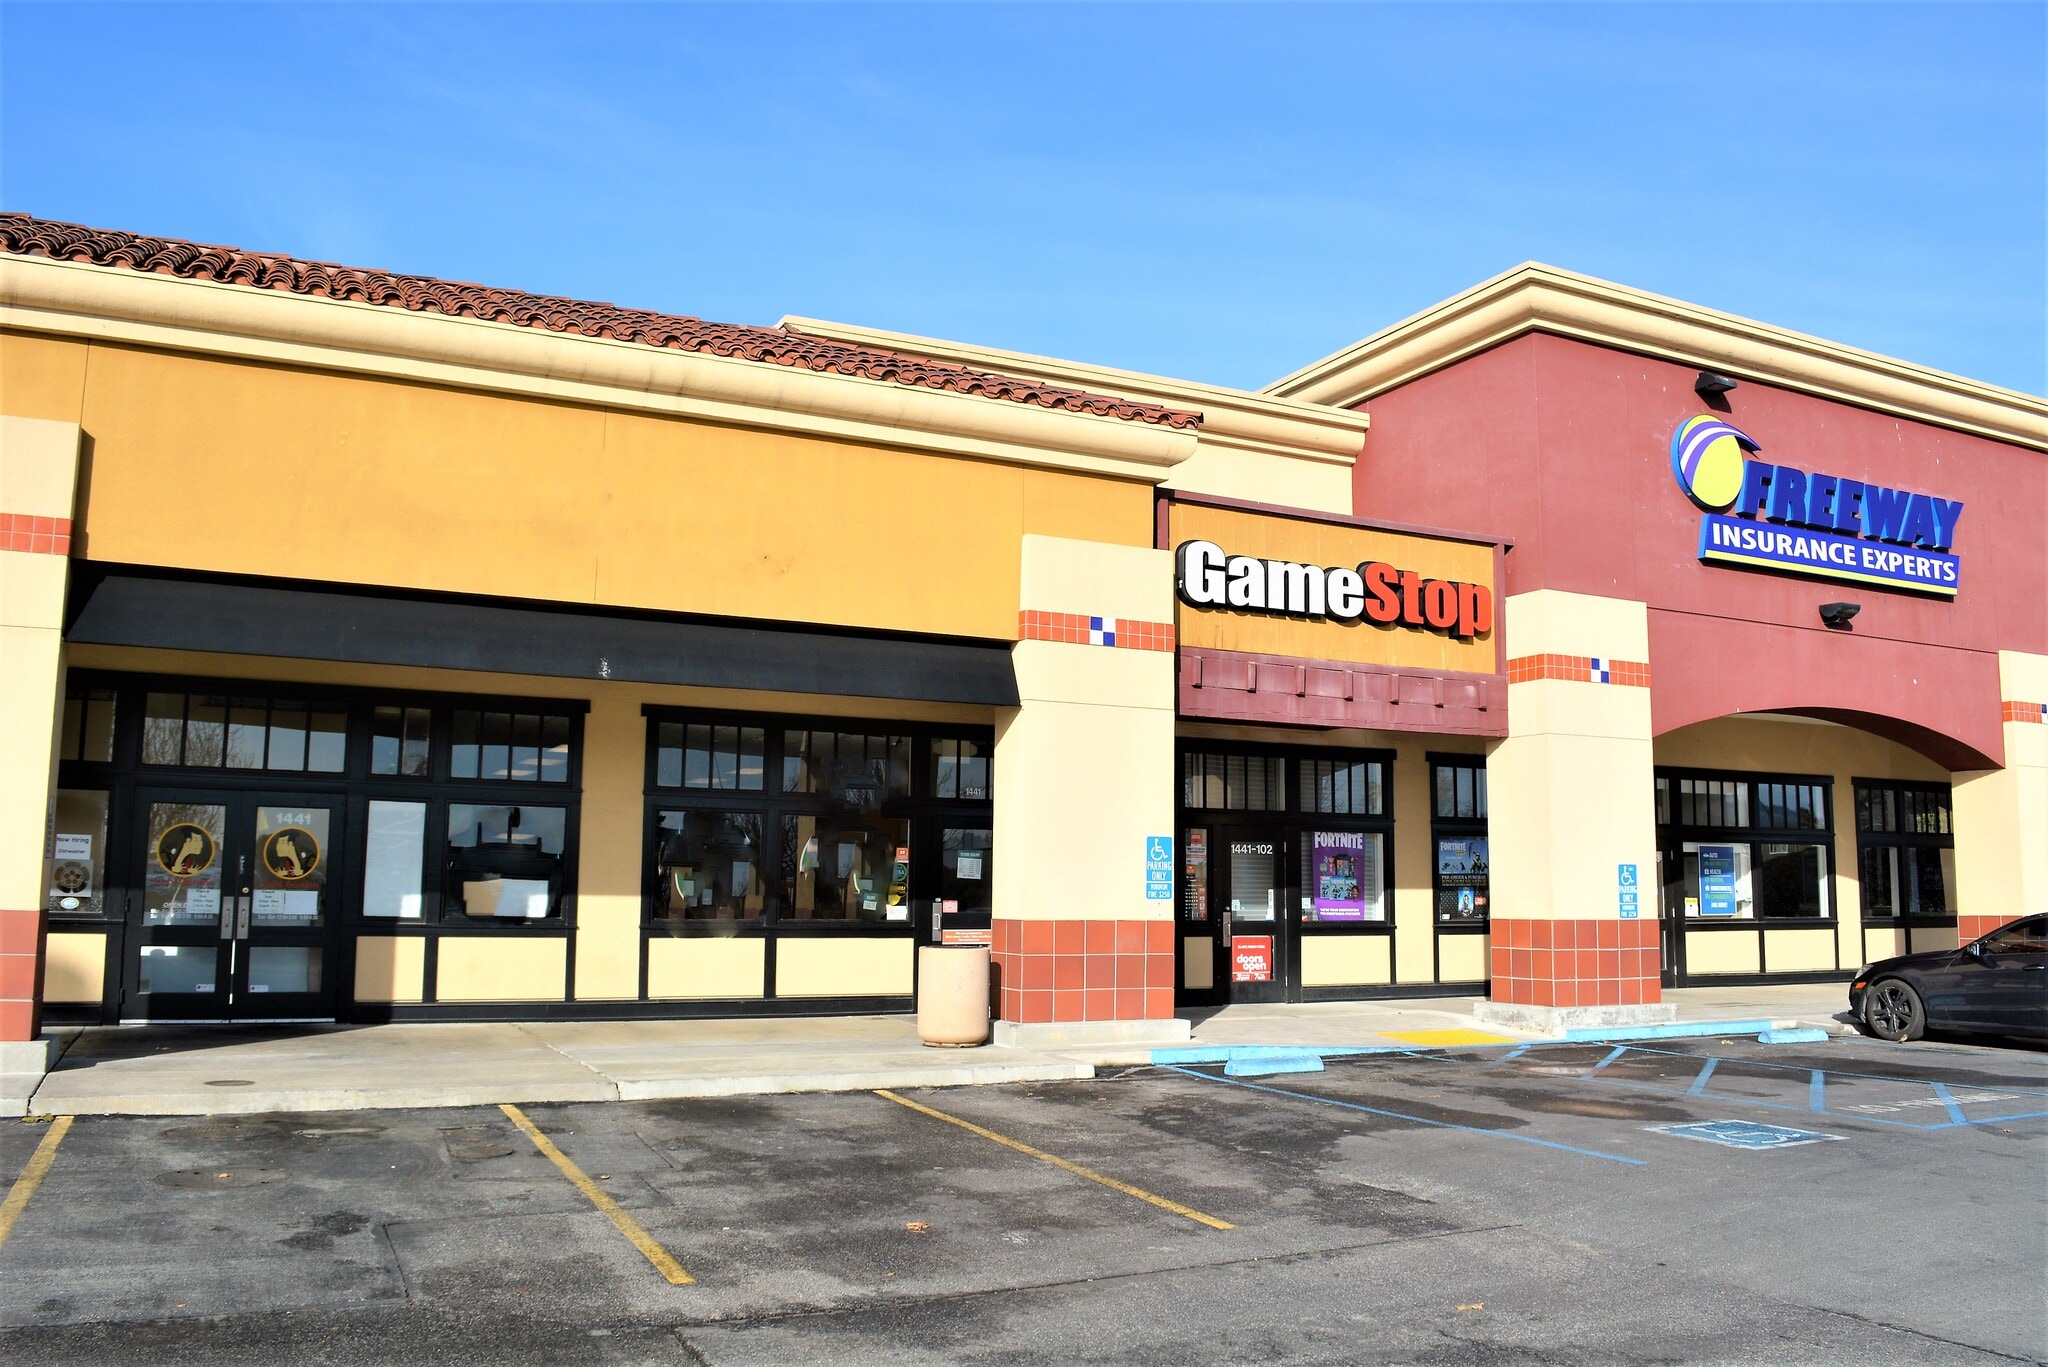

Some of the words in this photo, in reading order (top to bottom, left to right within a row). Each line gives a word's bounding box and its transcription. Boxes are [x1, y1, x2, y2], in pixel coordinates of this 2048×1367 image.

[1736, 460, 1964, 551] FREEWAY
[1712, 522, 1857, 566] INSURANCE
[1862, 547, 1957, 583] EXPERTS
[1182, 540, 1492, 637] GameStop
[965, 787, 981, 796] 1441
[276, 812, 312, 825] 1441
[71, 837, 90, 845] Hiring
[1314, 831, 1363, 850] FORTNITE
[1440, 841, 1466, 851] FORTNITE
[1231, 844, 1273, 855] 1441-102
[1147, 860, 1172, 871] PARKING
[1151, 871, 1166, 881] ONLY
[1147, 890, 1158, 898] FINE
[1159, 890, 1171, 898] $250
[1236, 953, 1264, 964] doors
[1242, 962, 1267, 973] open
